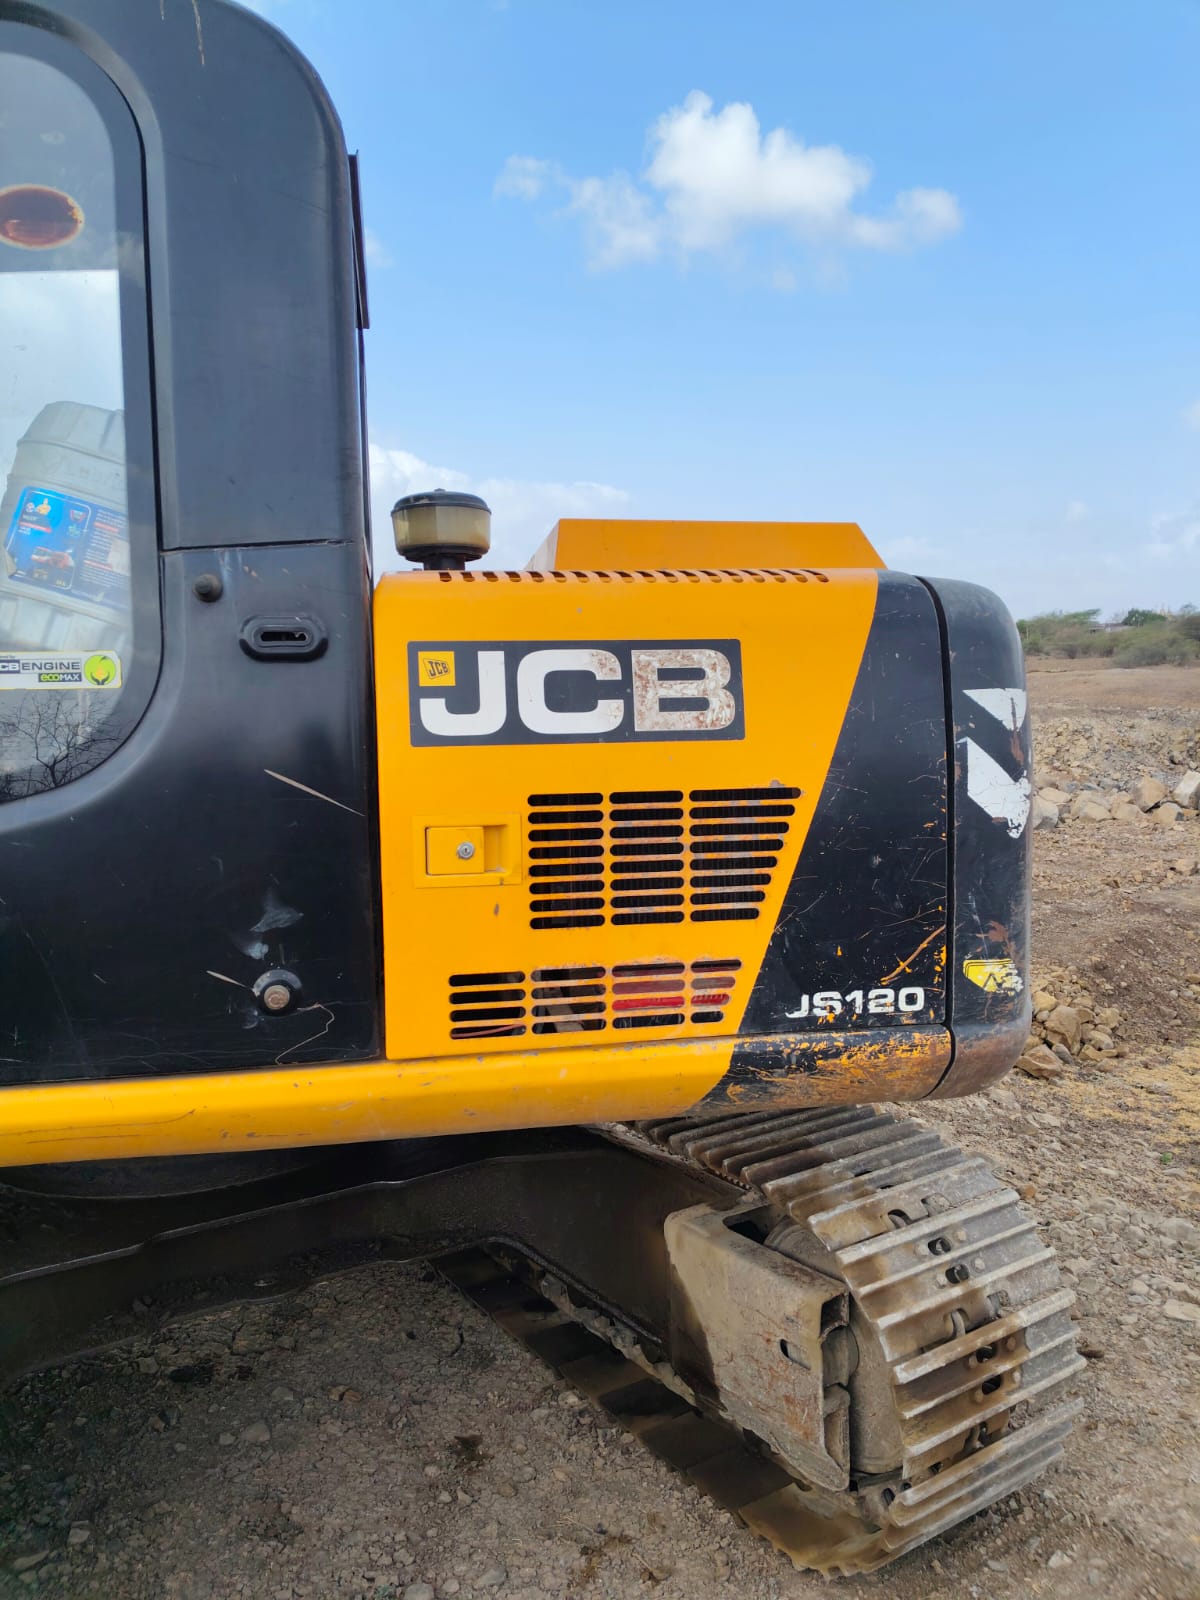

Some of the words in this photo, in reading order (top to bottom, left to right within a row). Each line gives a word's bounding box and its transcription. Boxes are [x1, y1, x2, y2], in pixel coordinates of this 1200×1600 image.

[21, 662, 80, 671] ENGINE
[427, 660, 449, 677] JCB
[419, 649, 736, 736] JCB
[785, 986, 925, 1018] JS120
